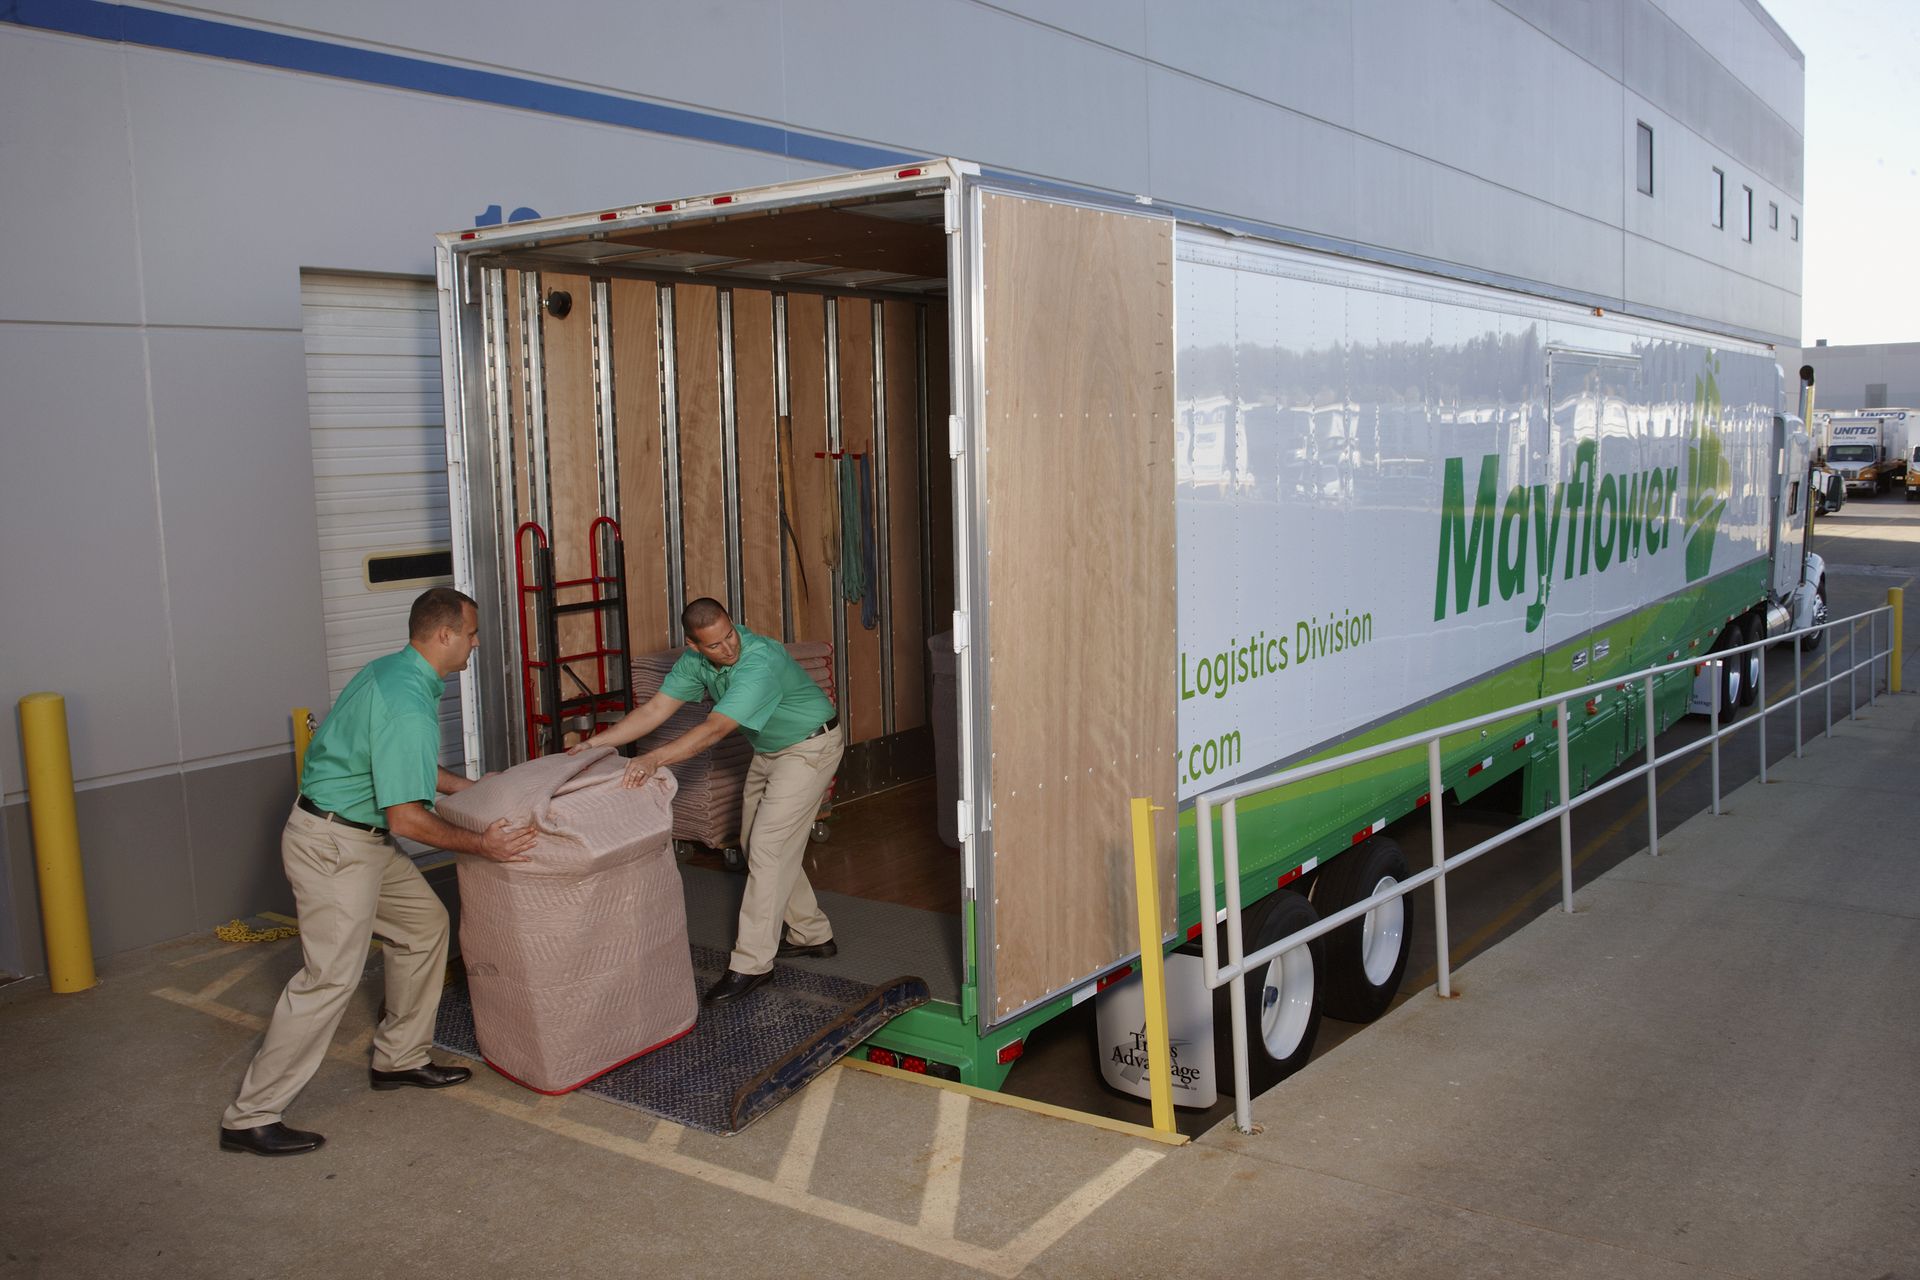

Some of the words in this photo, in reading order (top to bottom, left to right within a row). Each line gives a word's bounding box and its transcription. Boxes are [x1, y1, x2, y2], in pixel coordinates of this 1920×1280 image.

[1834, 427, 1876, 435] UNITED
[1434, 436, 1678, 633] Mayflower
[1181, 630, 1288, 700] Logistics
[1296, 608, 1372, 664] Division
[1129, 1031, 1178, 1058] Trs
[1111, 1045, 1200, 1084] Advaage
